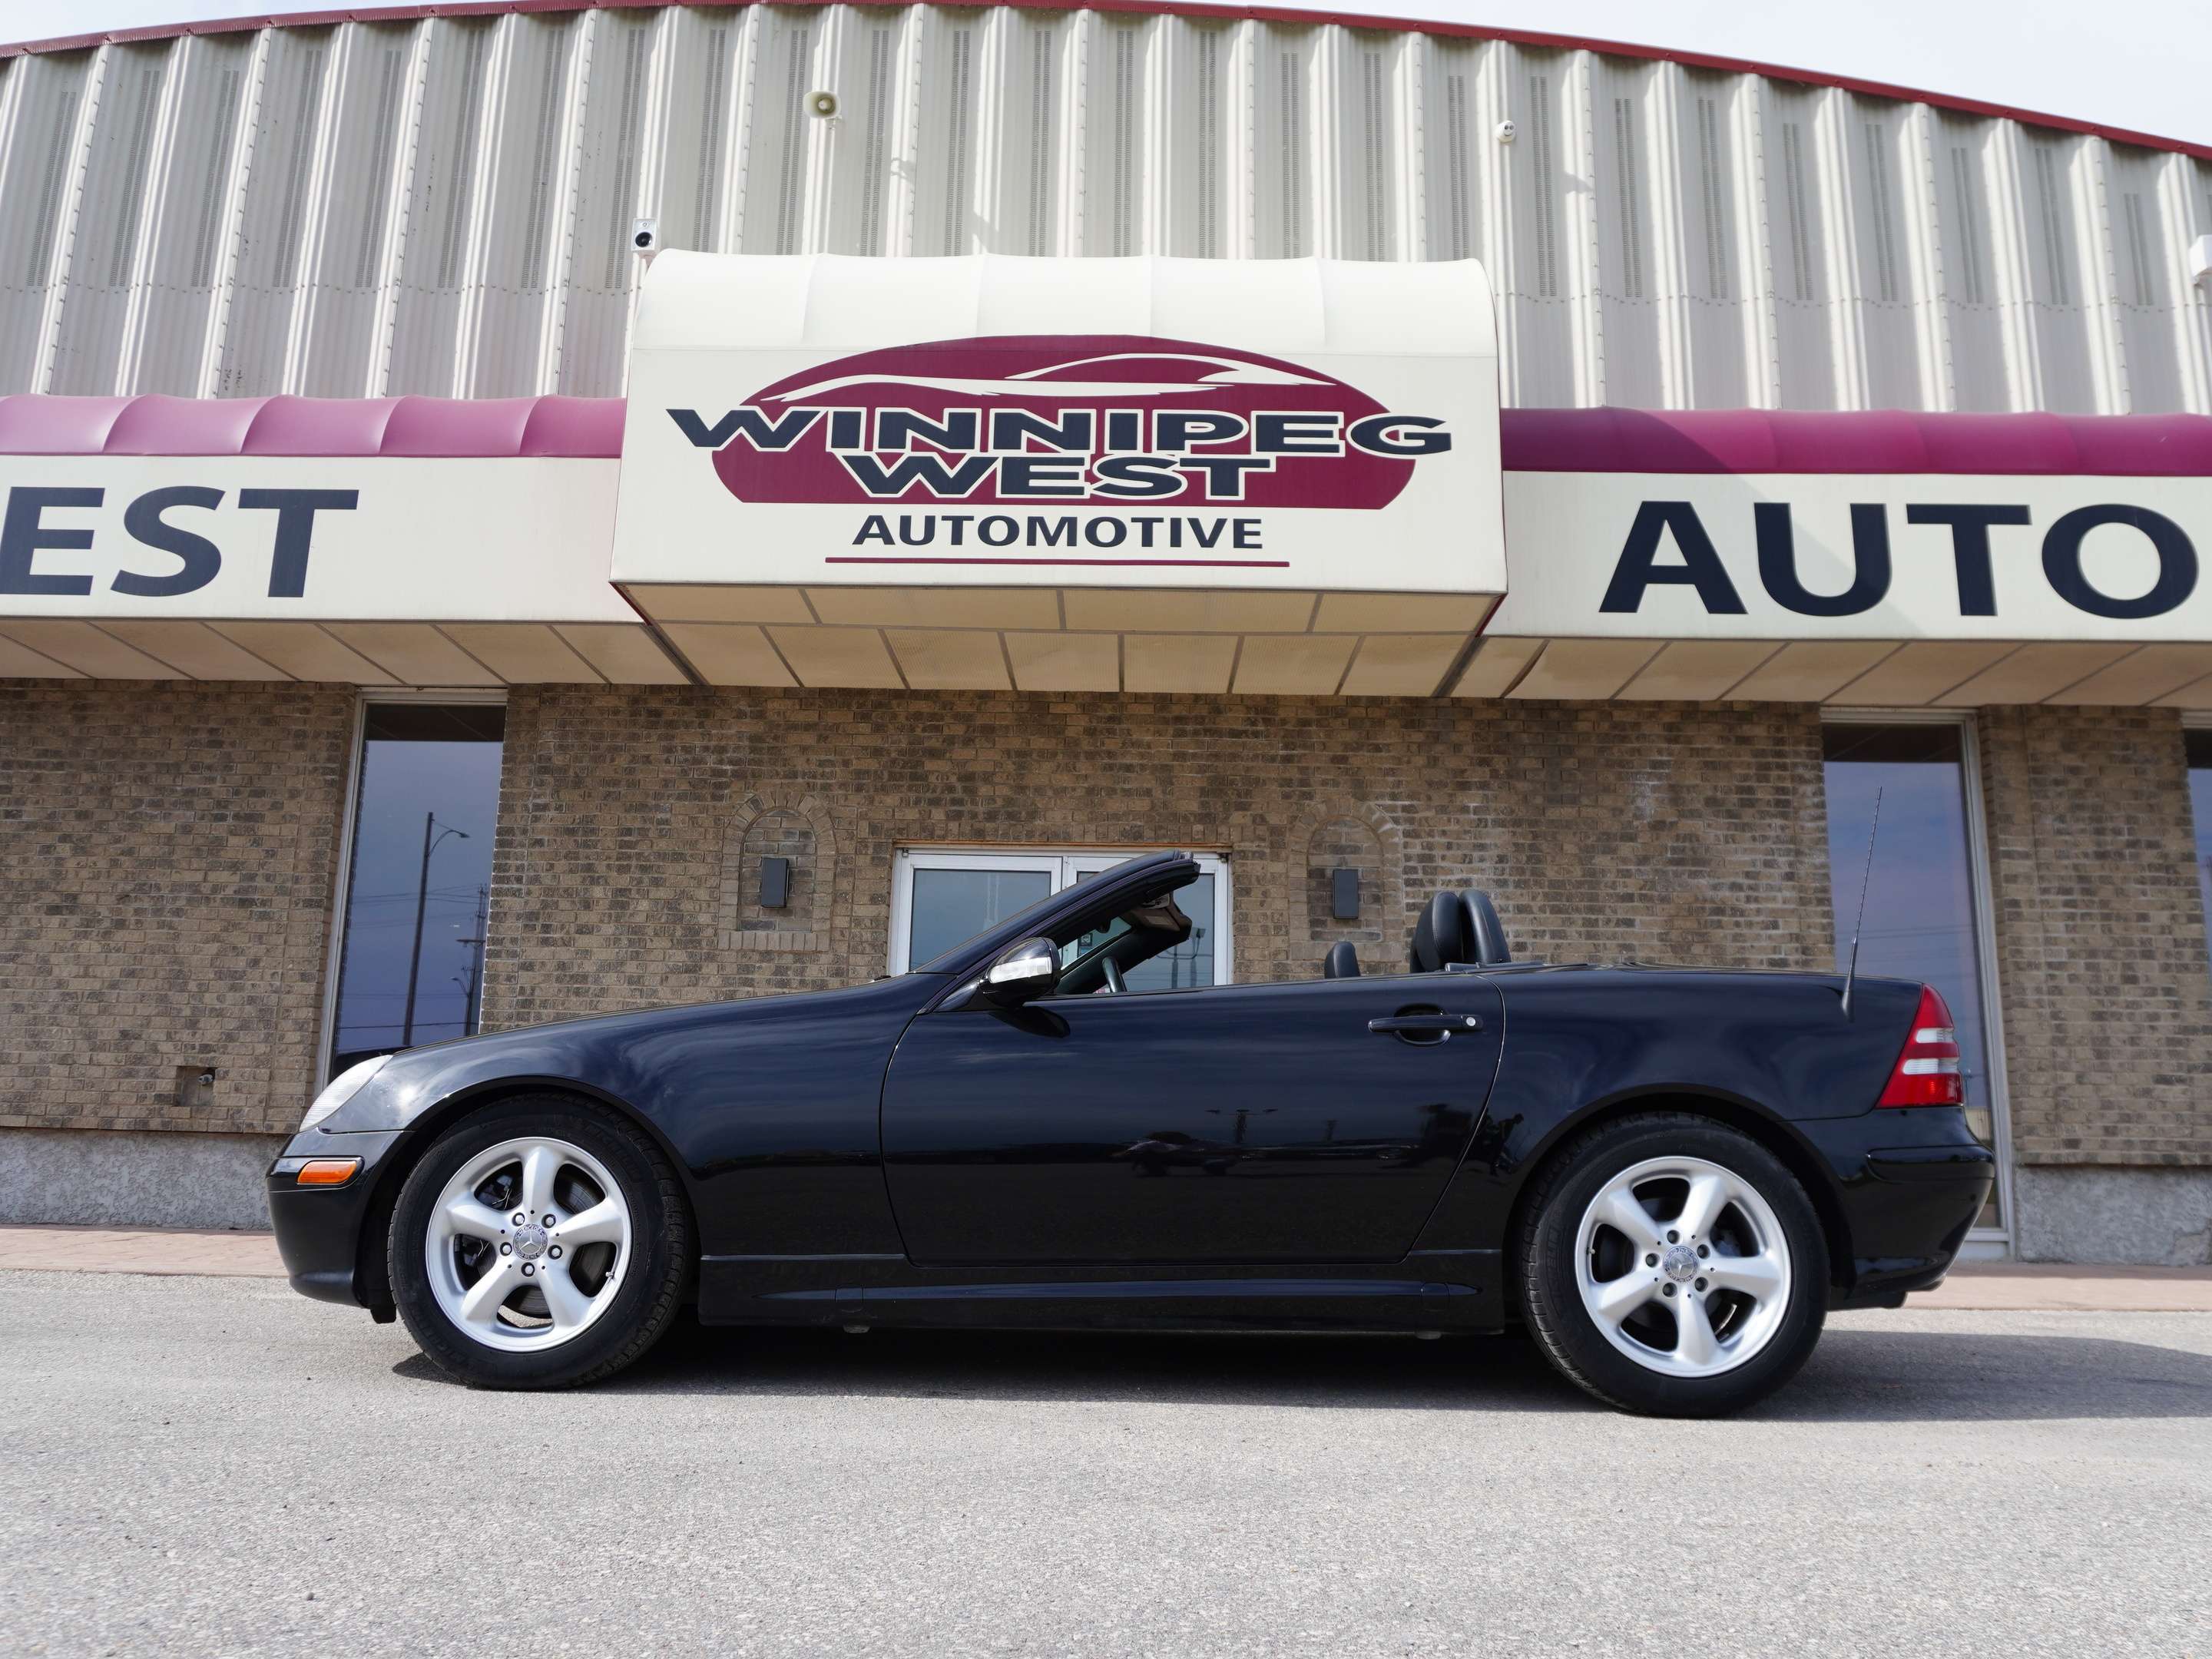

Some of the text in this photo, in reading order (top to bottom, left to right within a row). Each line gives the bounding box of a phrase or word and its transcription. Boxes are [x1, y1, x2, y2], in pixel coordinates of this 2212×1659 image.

[666, 409, 1452, 456] WINNIPEG
[842, 455, 1270, 498] WEST
[0, 486, 359, 598] EST
[852, 515, 1262, 549] AUTOMOTIVE
[1598, 501, 2198, 619] AUTO
